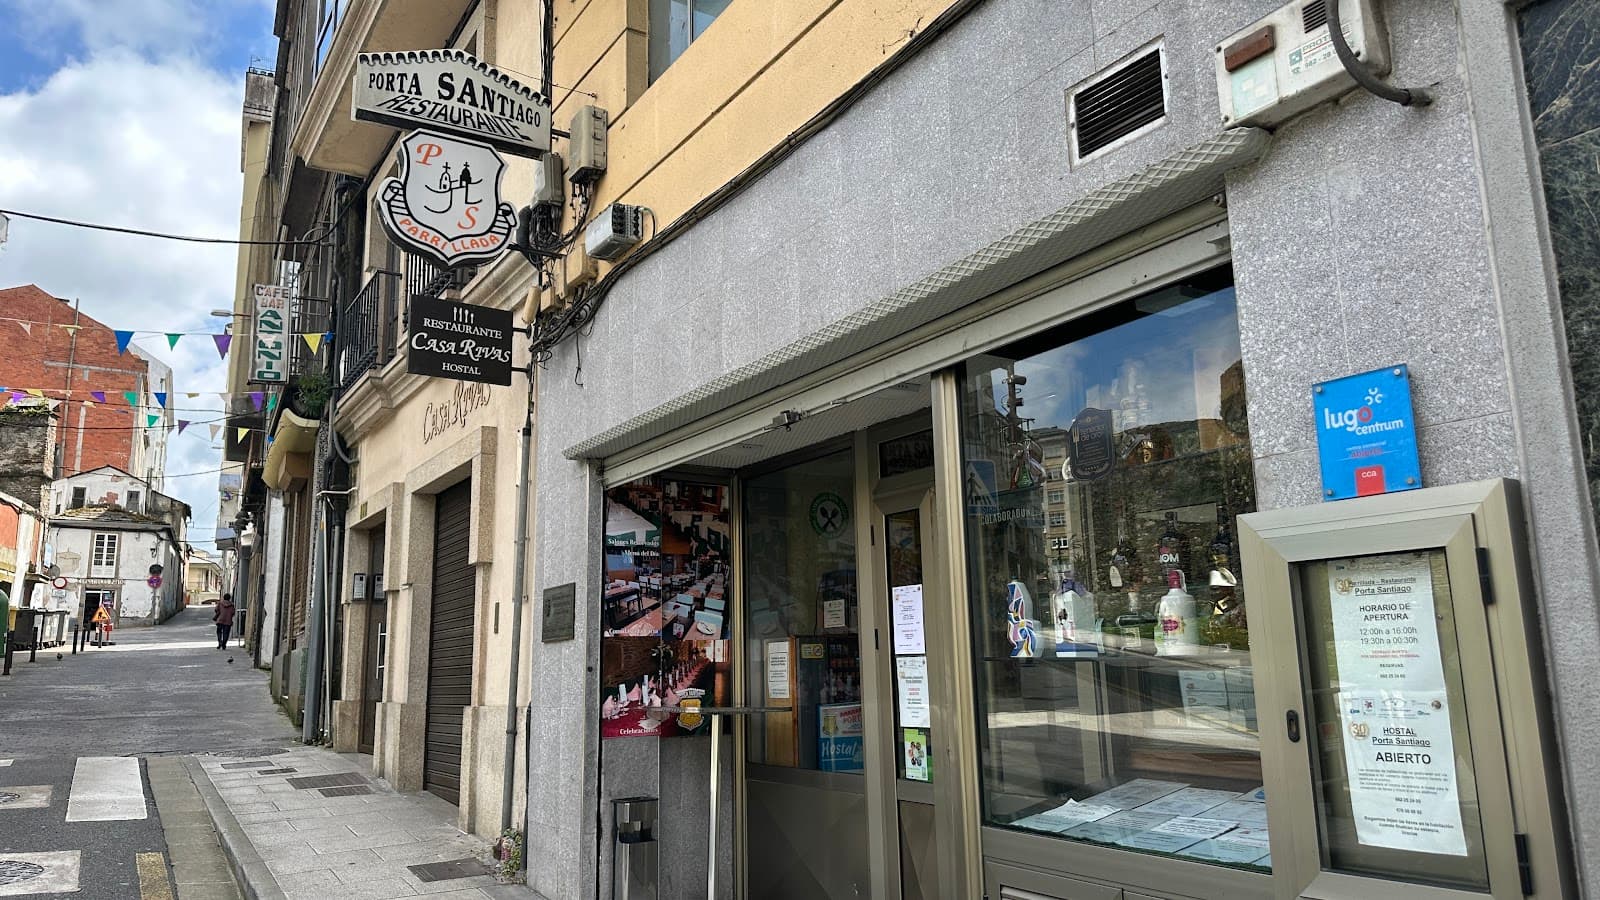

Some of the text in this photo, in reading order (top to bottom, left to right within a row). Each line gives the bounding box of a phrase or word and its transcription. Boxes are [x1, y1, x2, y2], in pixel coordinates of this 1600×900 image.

[369, 73, 541, 128] PORTA SANTIAGO
[376, 95, 534, 142] RESTAURANTE
[415, 143, 443, 166] P
[457, 206, 480, 230] S
[256, 286, 289, 298] CAFE
[261, 299, 284, 309] BAR
[423, 317, 503, 340] RESTAURANTE
[411, 332, 512, 363] CASA RIVAS
[442, 362, 482, 375] HOSTAL
[1324, 406, 1373, 432] lugo
[1355, 418, 1404, 436] centrum
[1361, 470, 1377, 479] cca
[1354, 585, 1411, 595] Porta Santiago
[1364, 613, 1408, 621] APERTURA
[1383, 727, 1416, 735] HOSTAL
[821, 740, 858, 757] Hostal
[1372, 736, 1431, 747] Porta Santiago
[1376, 752, 1431, 764] ABIERTO
